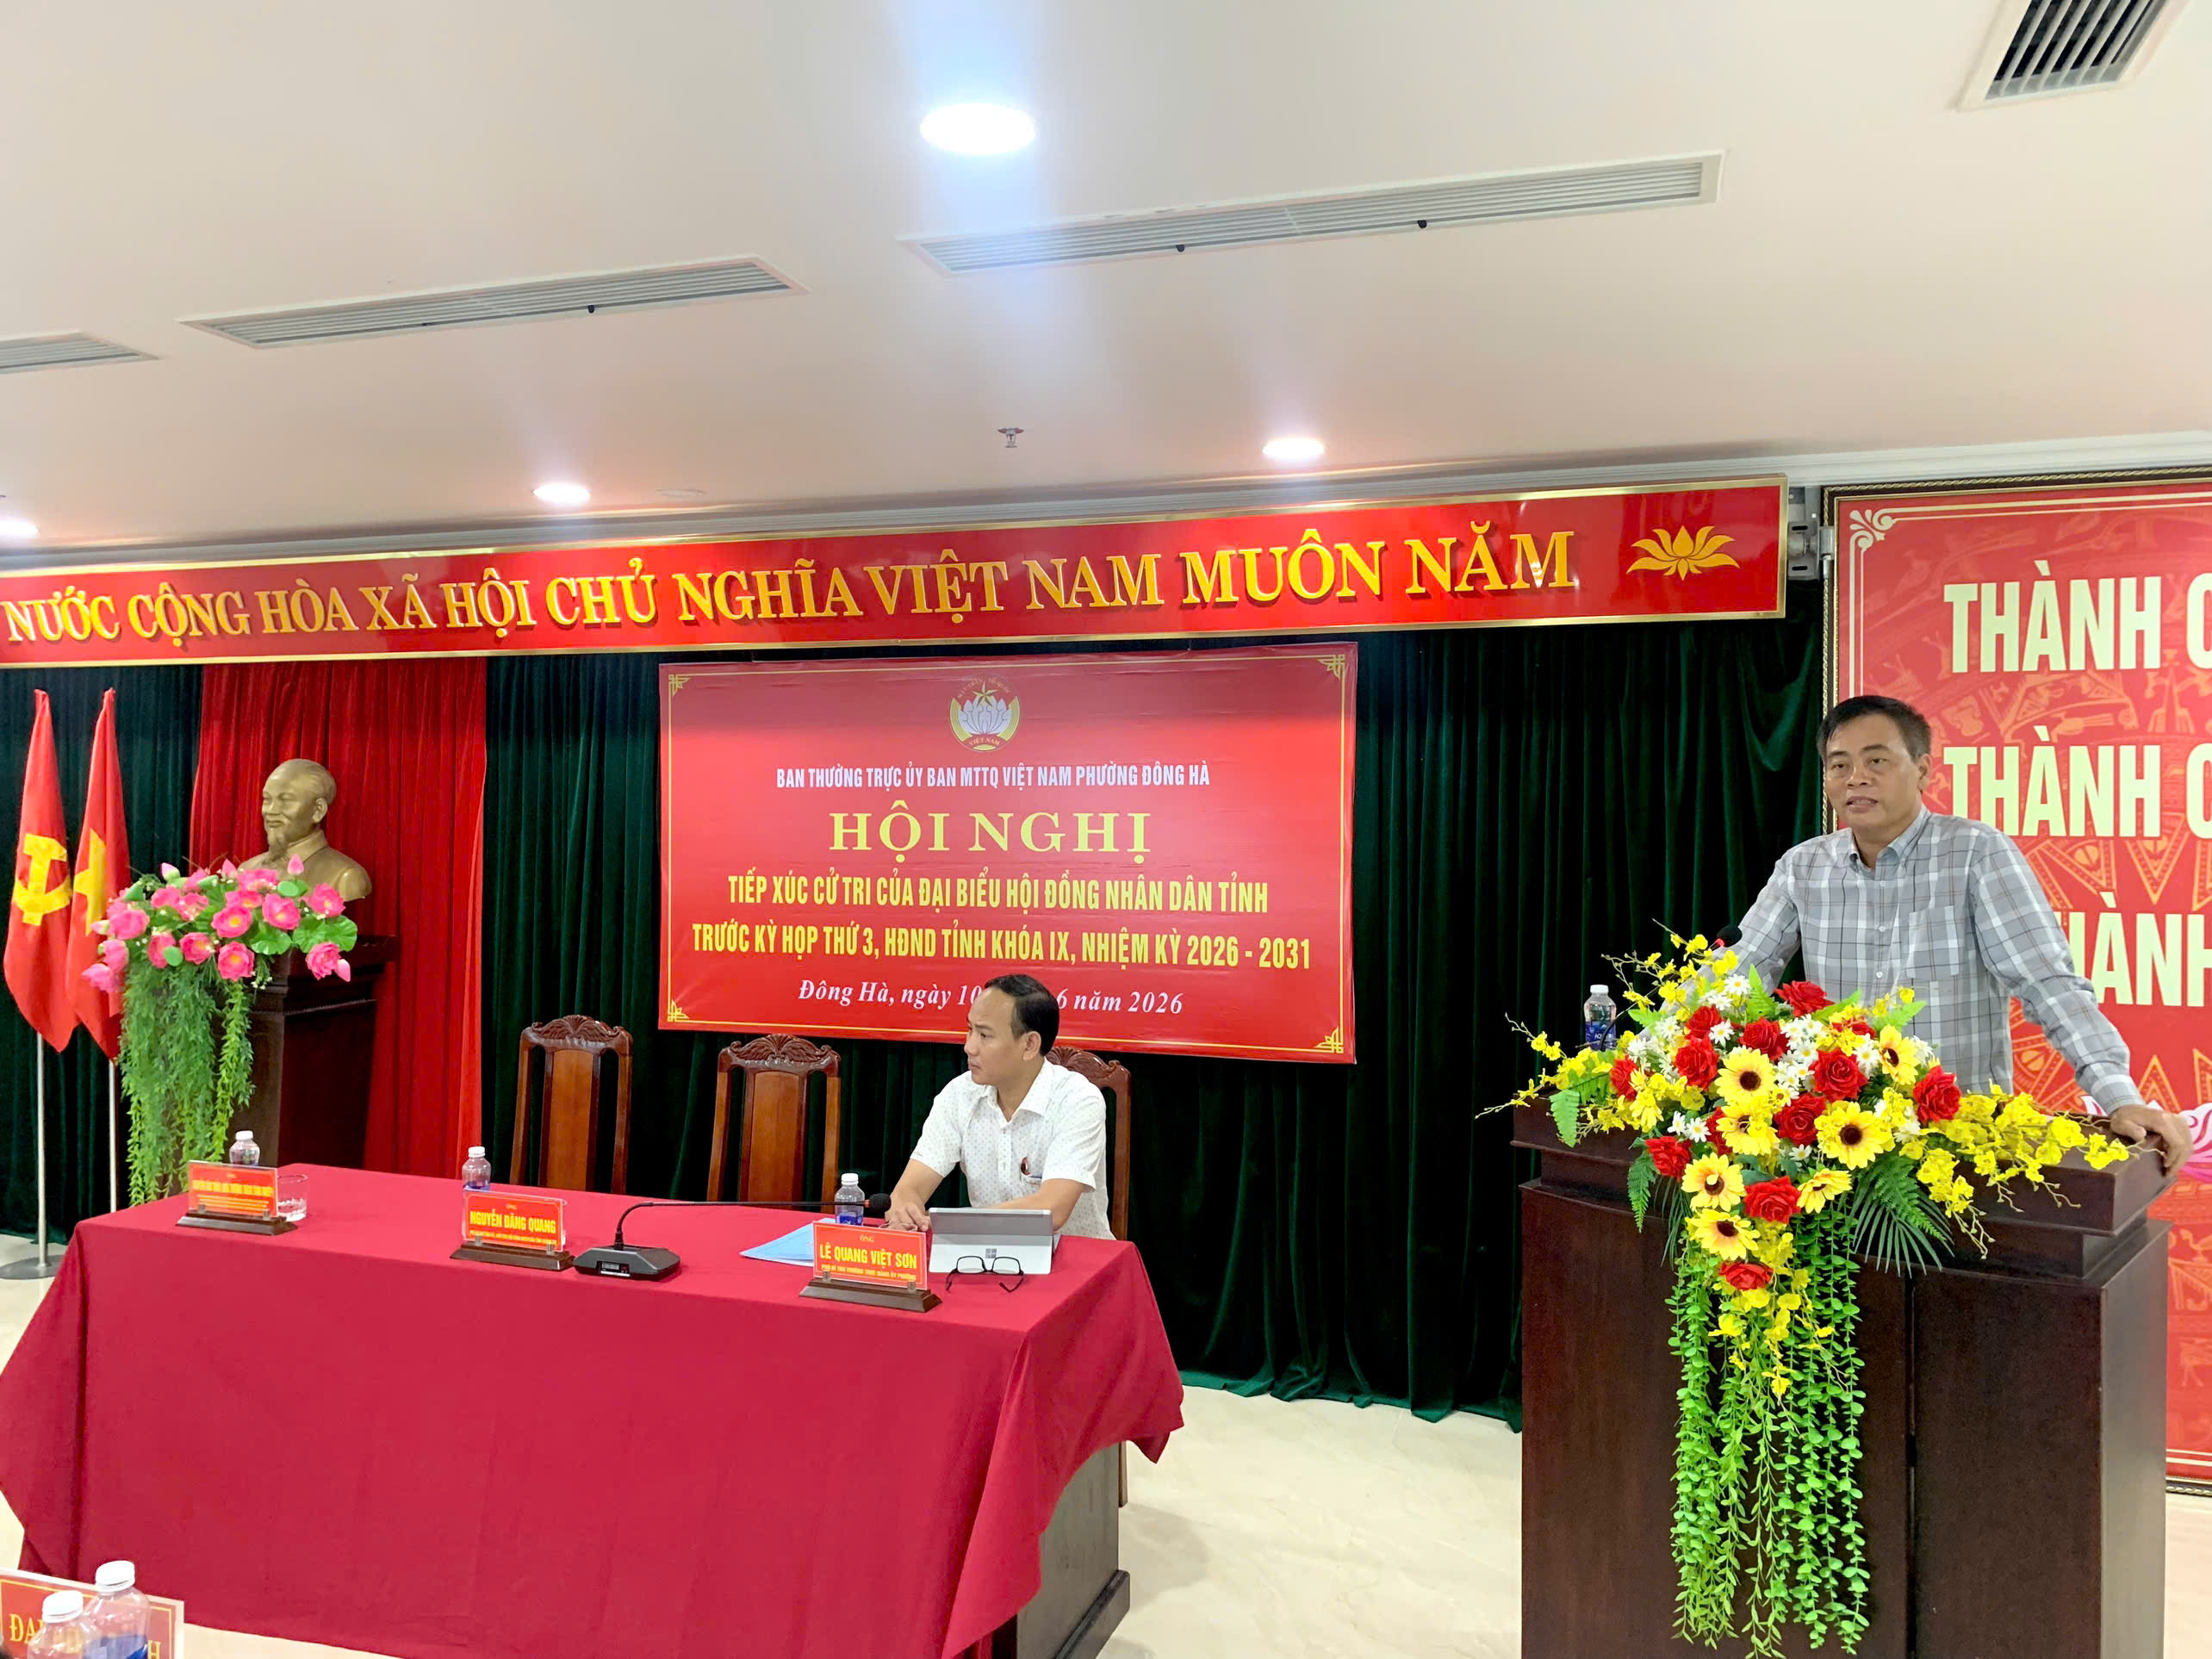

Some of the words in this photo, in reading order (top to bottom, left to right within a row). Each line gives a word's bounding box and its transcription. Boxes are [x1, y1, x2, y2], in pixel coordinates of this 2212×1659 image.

[0, 586, 120, 641] NƯỚC
[127, 581, 251, 648] CỘNG
[260, 578, 359, 633] HÒA
[358, 573, 436, 631] XÃ
[440, 567, 535, 638] HỘI
[546, 557, 656, 627] CHỦ
[672, 559, 863, 620] NGHĨA
[863, 549, 1010, 624] VIỆT
[1022, 554, 1165, 610] NAM
[1179, 528, 1385, 605] MUÔN
[1405, 519, 1575, 594] NĂM
[1944, 560, 2160, 673] THÀNH
[777, 767, 805, 788] BAN
[808, 763, 862, 788] THƯỜNG
[867, 765, 902, 792] TRỰC
[905, 761, 923, 787] ỦY
[928, 767, 956, 787] BAN
[960, 767, 998, 789] MTTQ
[1003, 762, 1034, 791] VIỆT
[1037, 766, 1072, 786] NAM
[1077, 761, 1138, 786] PHƯỜNG
[1142, 761, 1184, 786] ĐÔNG
[1189, 760, 1210, 786] HÀ
[1944, 726, 2160, 838] THÀNH
[830, 799, 949, 863] HỘI
[968, 812, 1151, 864] NGHỊ
[728, 867, 767, 904] TIẾP
[772, 870, 808, 904] XÚC
[813, 867, 839, 905] CỬ
[842, 877, 871, 905] TRI
[876, 867, 914, 906] CỦA
[918, 878, 951, 913] ĐẠI
[957, 867, 1000, 908] BIỂU
[1006, 872, 1039, 915] HỘI
[1044, 869, 1100, 910] ĐỒNG
[1105, 873, 1163, 910] NHÂN
[1170, 874, 1212, 911] DÂN
[1218, 871, 1268, 913] TỈNH
[692, 918, 749, 953] TRƯỚC
[755, 919, 777, 953] KỲ
[782, 925, 818, 960] HỌP
[823, 921, 860, 955] THỨ
[862, 928, 879, 960] 3,
[885, 928, 936, 957] HĐND
[941, 919, 985, 958] TỈNH
[991, 924, 1044, 960] KHÓA
[1050, 931, 1076, 965] IX,
[1082, 927, 1148, 970] NHIỆM
[1155, 928, 1181, 965] KỲ
[1187, 935, 1239, 966] 2026
[1259, 937, 1309, 969] 2031
[2054, 892, 2212, 1007] ÀNH
[798, 979, 854, 1006] Đông
[858, 981, 894, 1006] Hà,
[901, 985, 952, 1010] ngày
[1073, 991, 1121, 1011] năm
[1128, 991, 1184, 1014] 2026
[819, 1242, 831, 1259] LÊ
[834, 1246, 867, 1264] QUANG
[871, 1248, 892, 1268] VIỆT
[895, 1252, 917, 1269] SƠN
